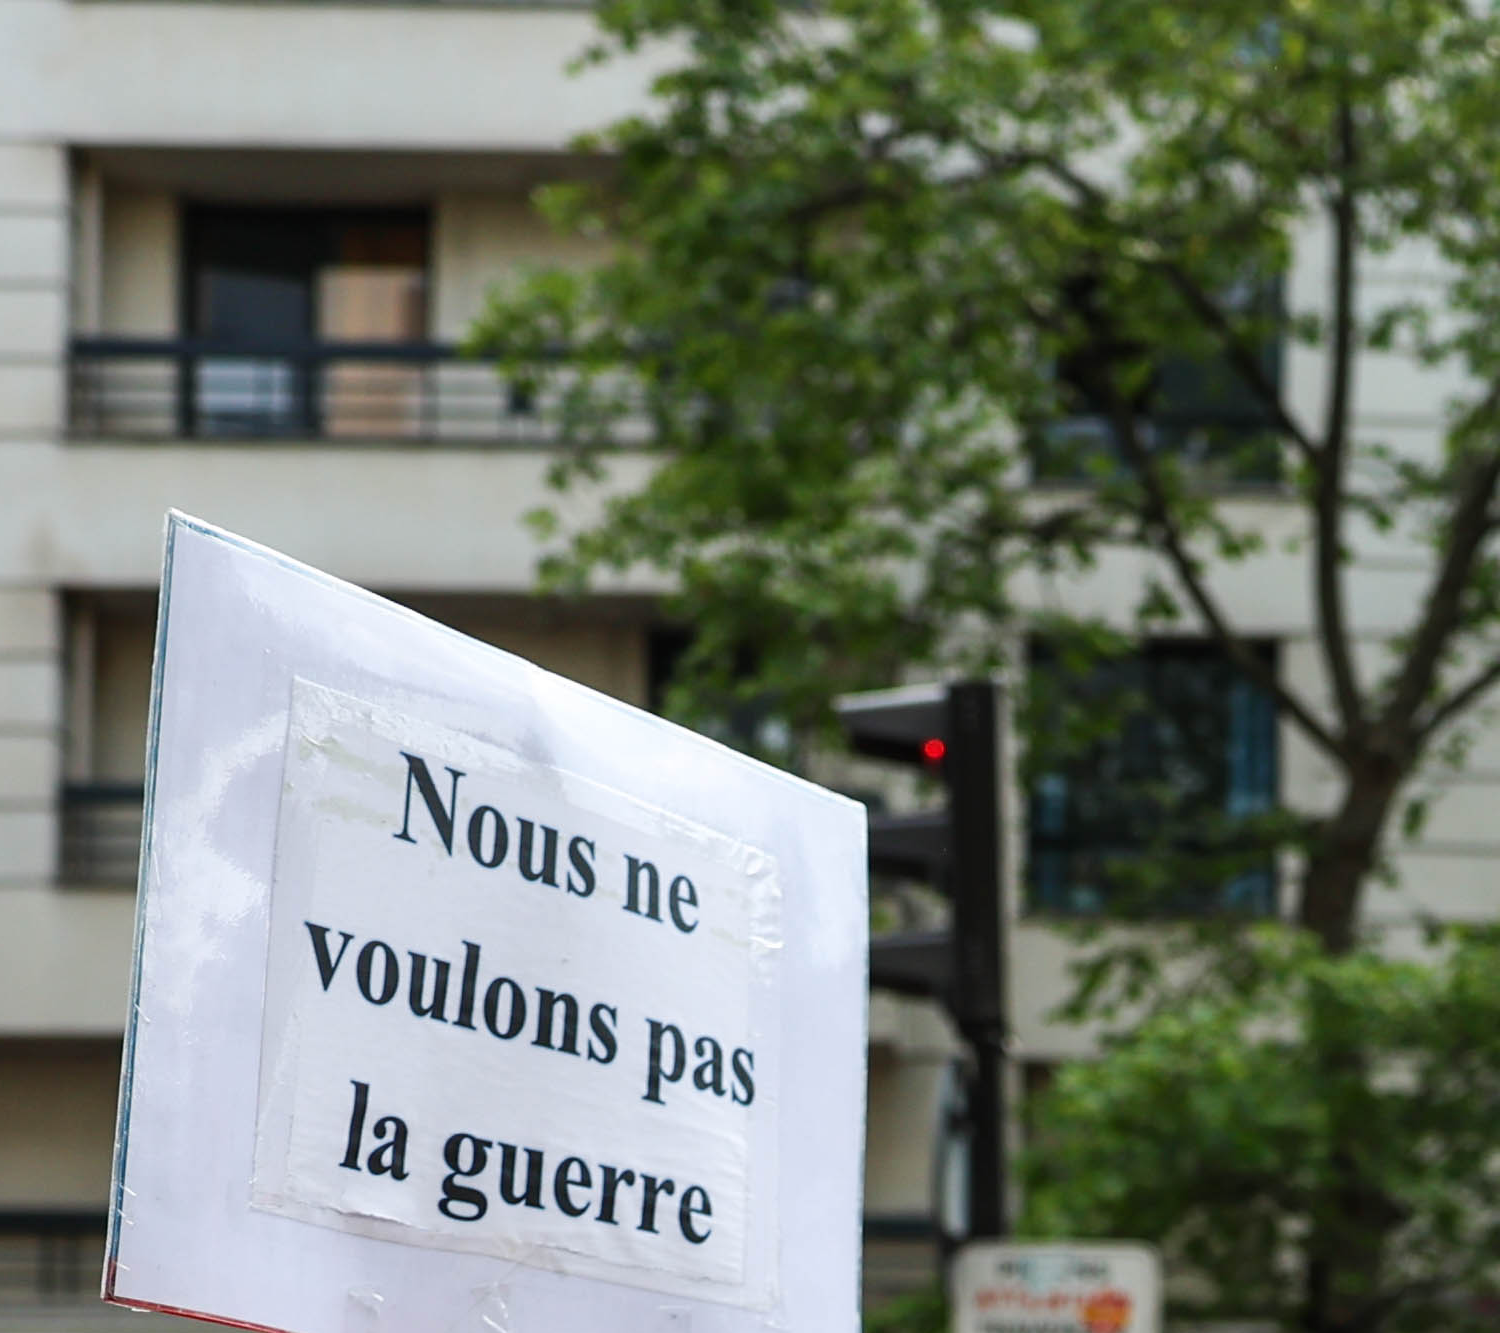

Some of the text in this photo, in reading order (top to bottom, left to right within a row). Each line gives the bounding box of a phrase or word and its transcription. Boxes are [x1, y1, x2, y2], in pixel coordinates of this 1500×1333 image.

[392, 751, 699, 934] Nous ne
[304, 921, 756, 1106] voulons pas
[338, 1079, 713, 1245] la guerre
